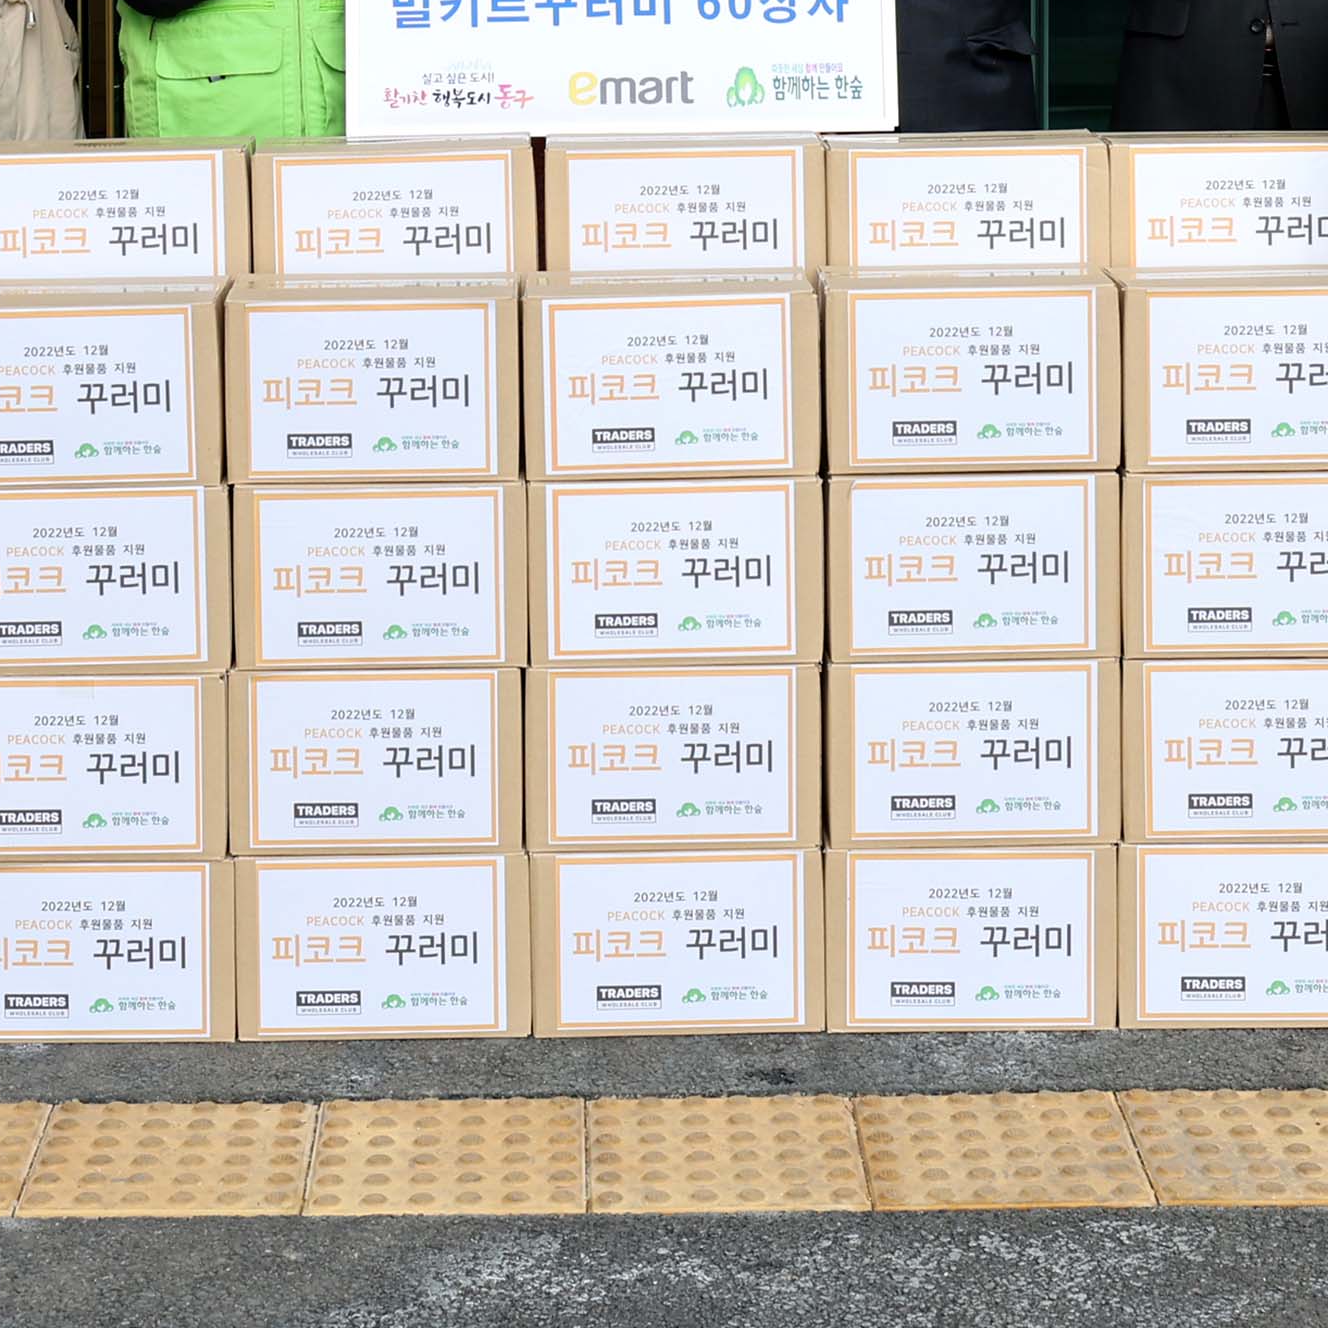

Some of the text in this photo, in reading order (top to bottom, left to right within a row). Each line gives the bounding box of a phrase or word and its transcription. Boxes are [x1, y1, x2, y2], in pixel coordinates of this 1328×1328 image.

[469, 71, 495, 84] 도시!
[568, 70, 695, 105] emart
[773, 75, 863, 100] 함께하는 한숲
[431, 87, 492, 109] 행복도시
[494, 83, 535, 110] 동구
[582, 218, 777, 253] 피코크 꾸러미
[24, 344, 108, 357] 2022년도 12월
[63, 363, 107, 375] 후원물품
[115, 362, 136, 374] 지원
[77, 380, 170, 414] 꾸러미
[571, 555, 770, 591] 피코크 꾸러미
